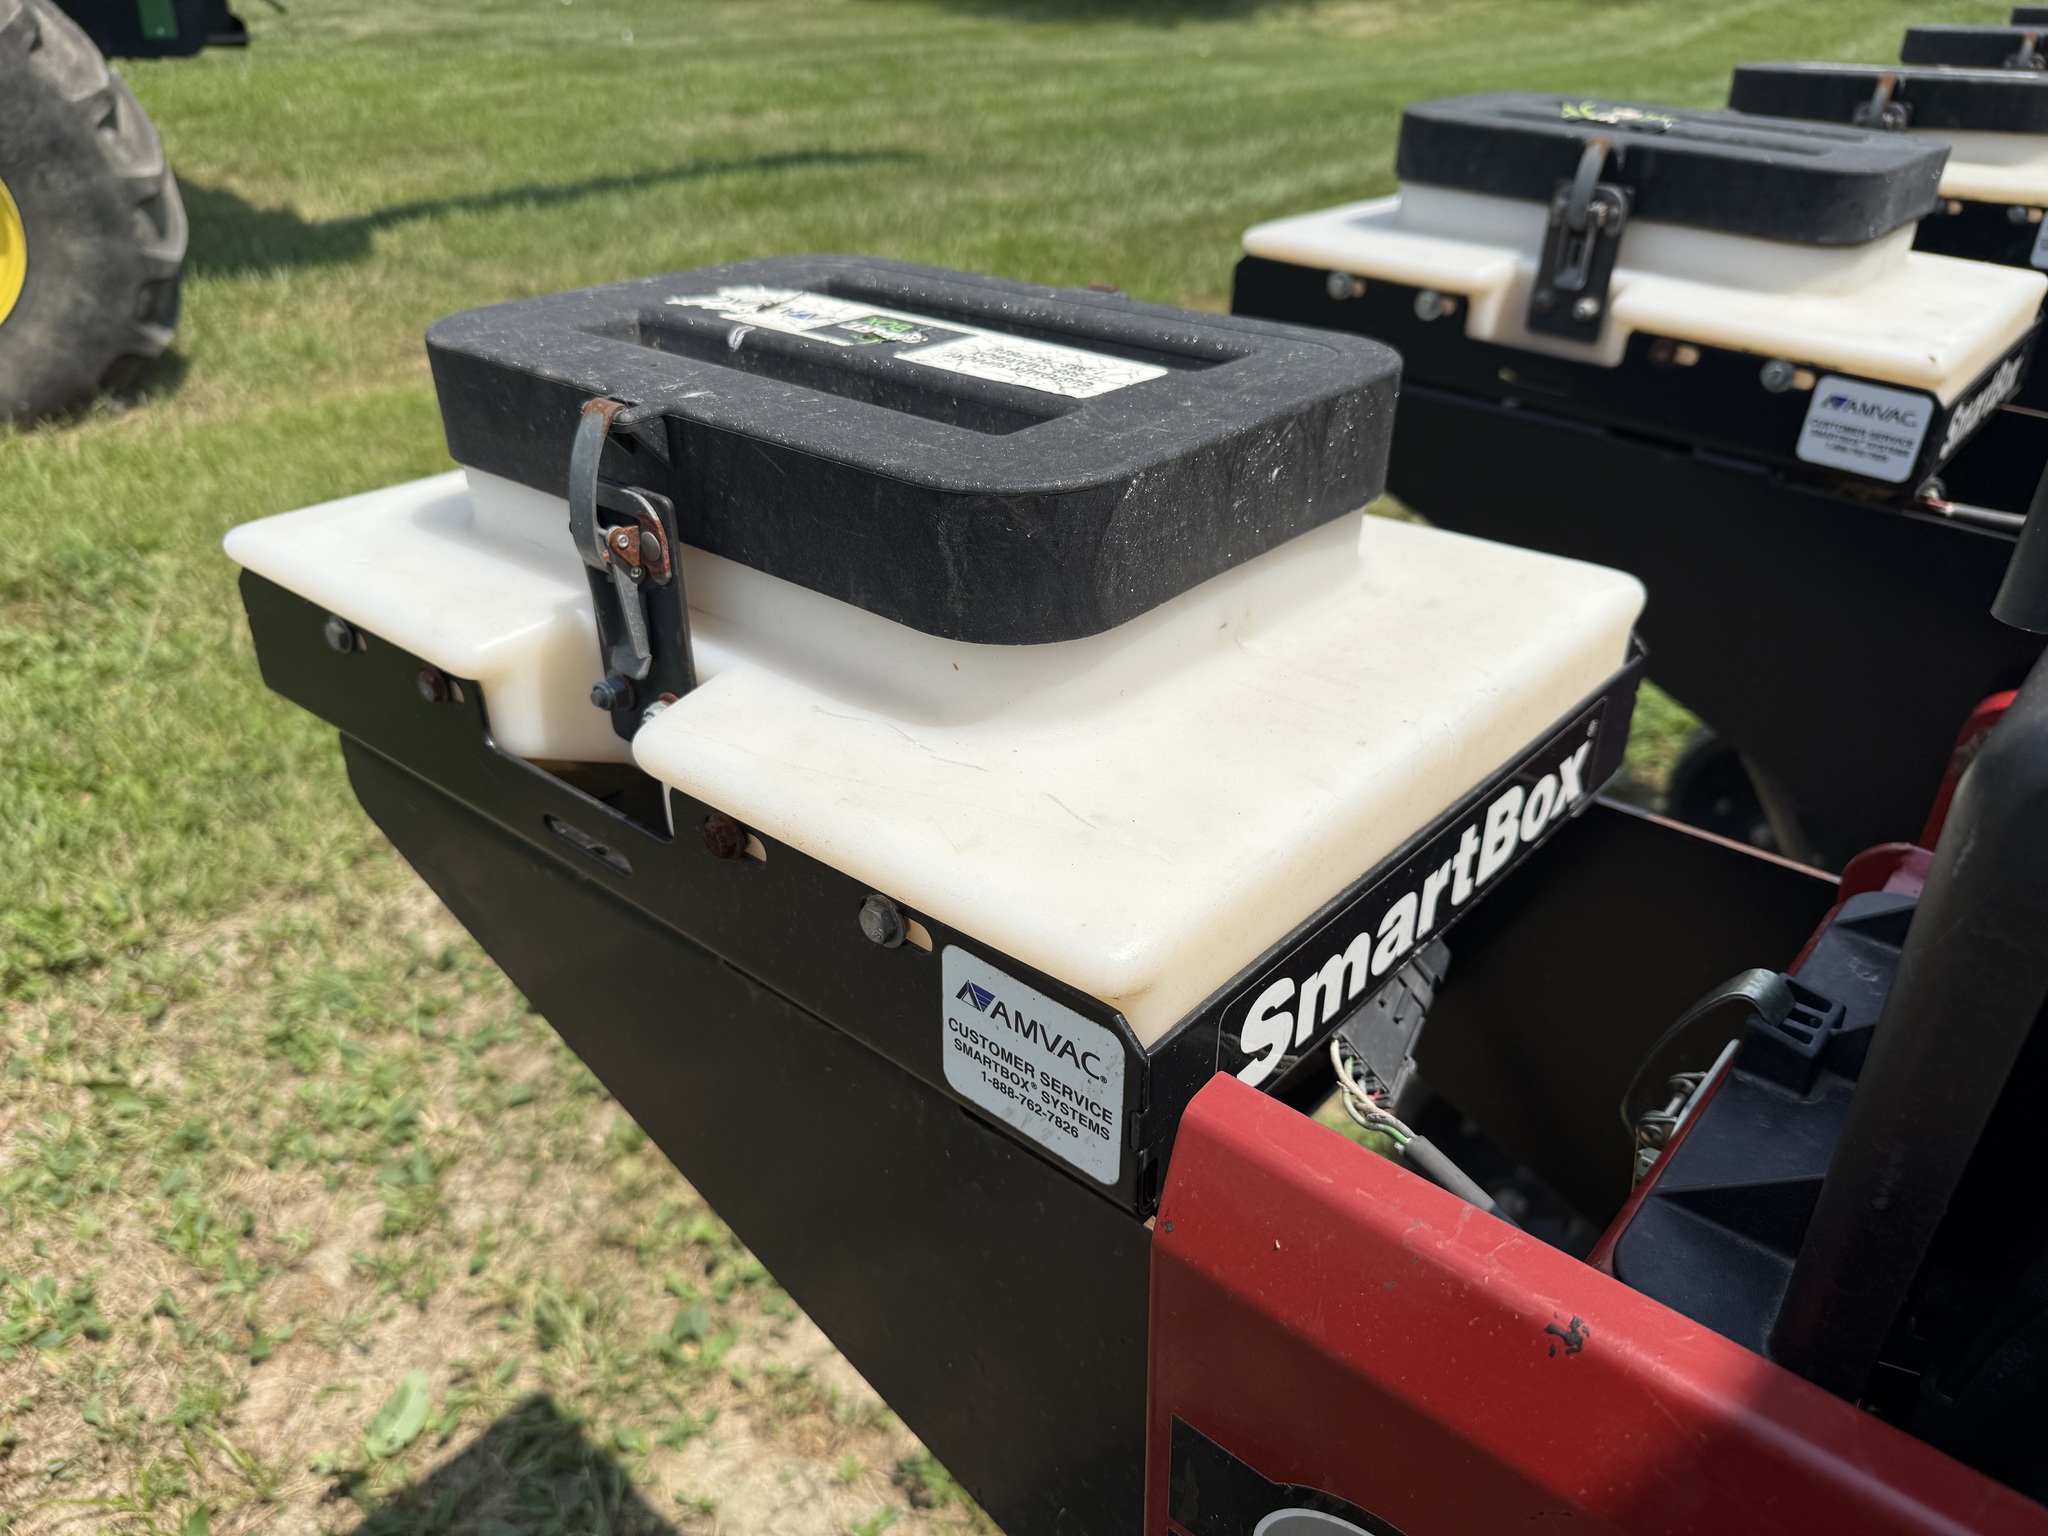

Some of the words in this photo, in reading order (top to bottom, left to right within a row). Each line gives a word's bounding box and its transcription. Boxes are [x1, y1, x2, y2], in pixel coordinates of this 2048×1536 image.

[1236, 740, 1592, 1088] SmartBox
[948, 1017, 1035, 1079] CUSTOMER
[1039, 1071, 1113, 1126] SERVICE
[981, 1071, 1079, 1139] 1-888-762-7826
[1041, 1091, 1110, 1141] SYSTEMS
